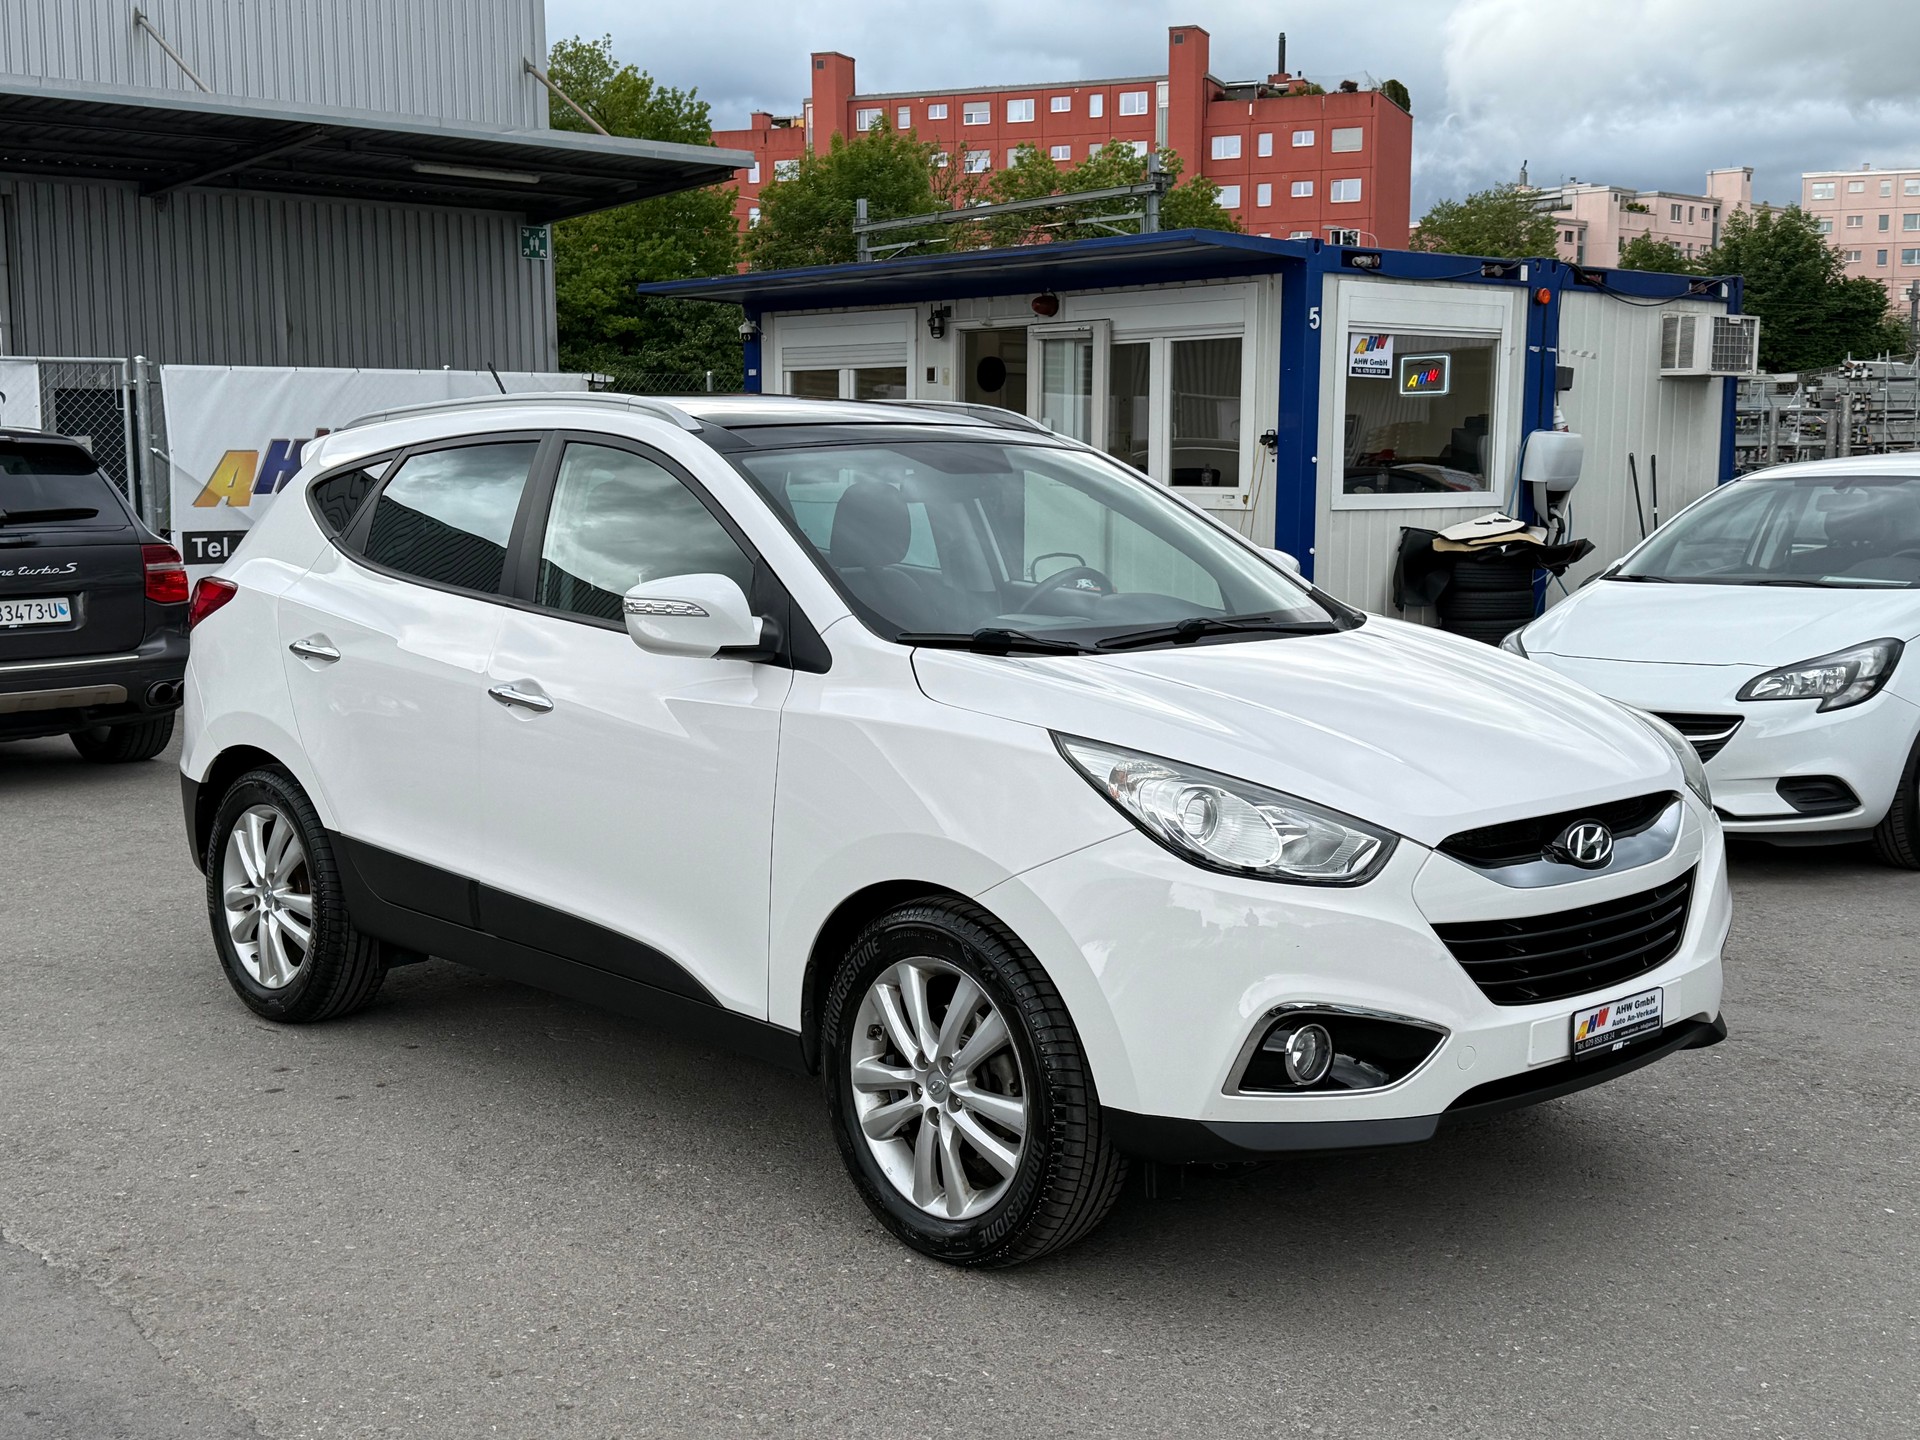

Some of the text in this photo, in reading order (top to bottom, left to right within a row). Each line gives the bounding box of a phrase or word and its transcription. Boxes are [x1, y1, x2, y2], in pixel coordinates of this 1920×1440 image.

[1309, 306, 1320, 330] 5
[1354, 334, 1389, 354] AHW
[1370, 359, 1388, 367] GmbH
[1407, 368, 1440, 388] AHW
[192, 537, 235, 558] Tel
[1616, 995, 1656, 1015] AHW GmbH
[1576, 1006, 1610, 1040] AHW
[1612, 1018, 1626, 1027] Auto
